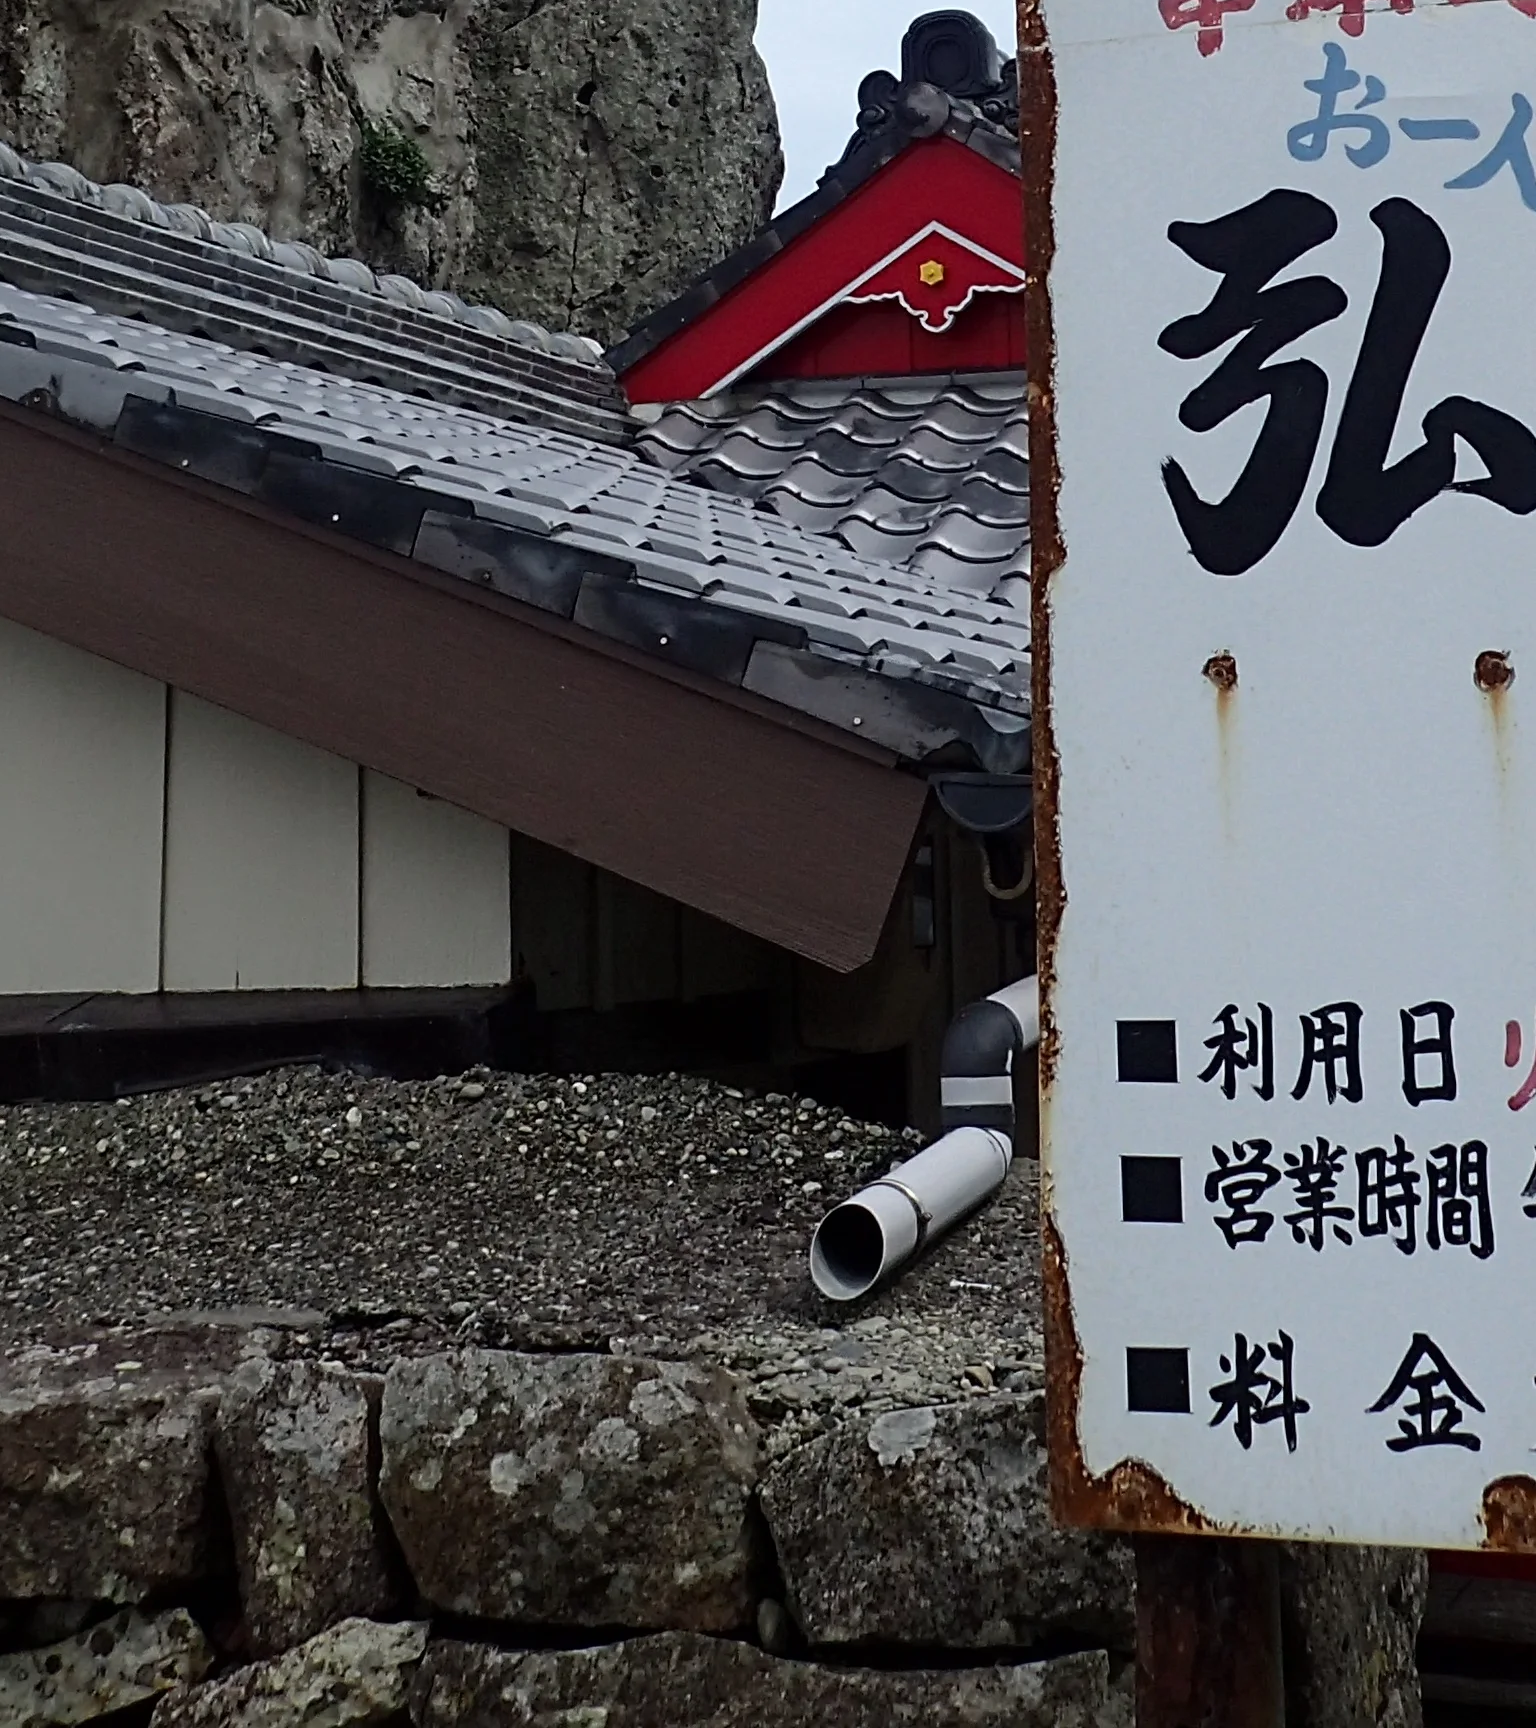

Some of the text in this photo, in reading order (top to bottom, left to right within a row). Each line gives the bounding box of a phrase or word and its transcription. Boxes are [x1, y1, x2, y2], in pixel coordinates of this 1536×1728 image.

[1196, 1000, 1458, 1109] 利用日
[1203, 1133, 1497, 1261] 営業時間
